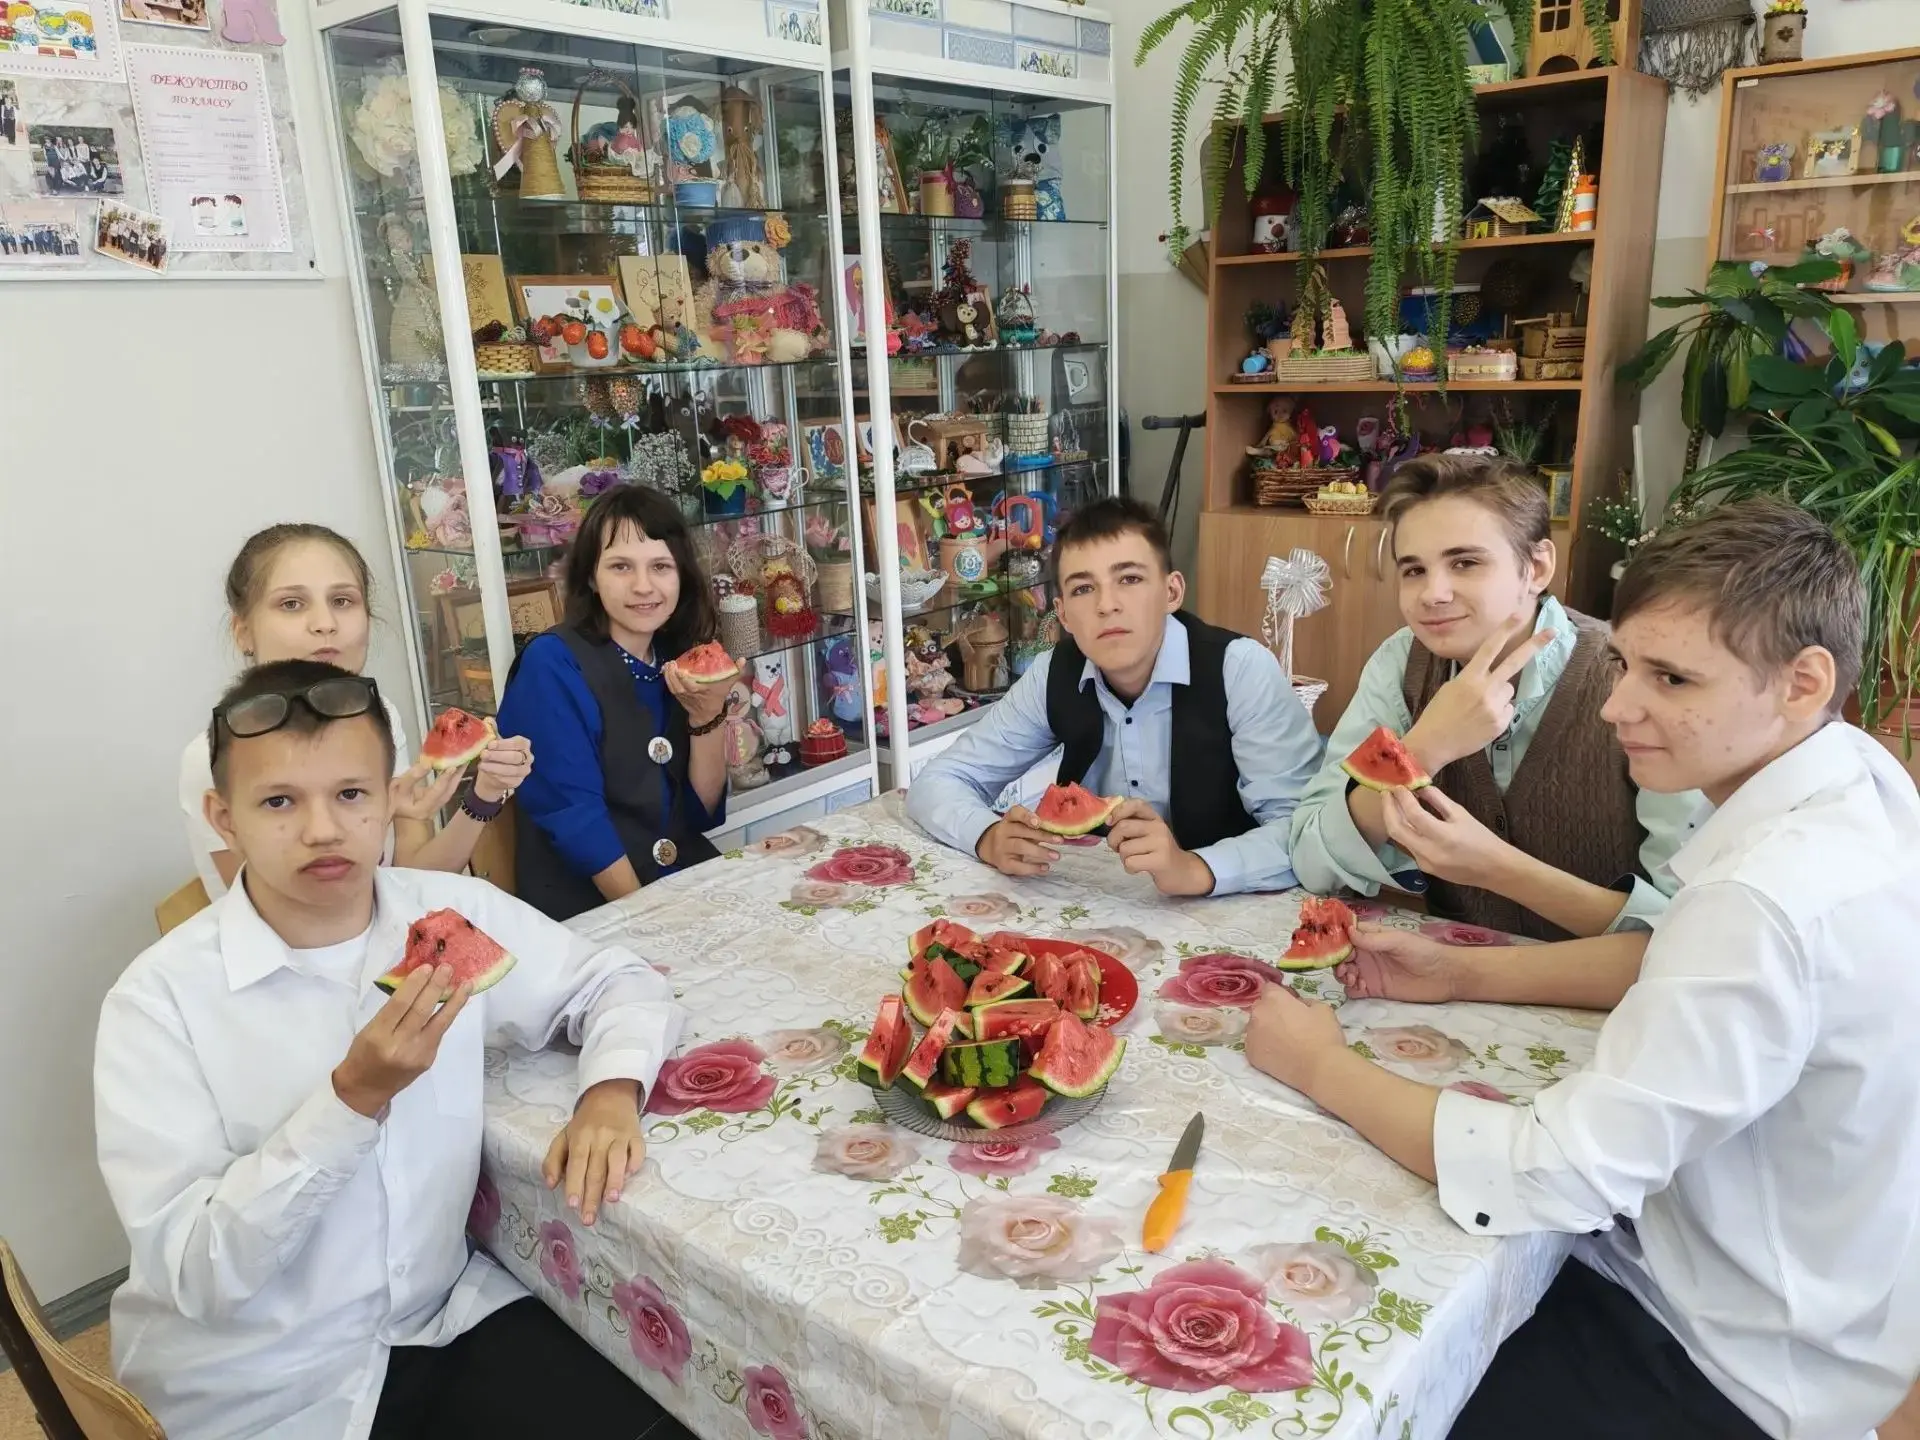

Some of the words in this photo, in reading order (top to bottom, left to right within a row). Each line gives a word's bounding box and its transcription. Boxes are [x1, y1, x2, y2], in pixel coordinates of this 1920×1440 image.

[150, 73, 248, 91] ДЕЖУРСТВО
[172, 95, 188, 104] ПО
[190, 96, 234, 109] КЛАССУ
